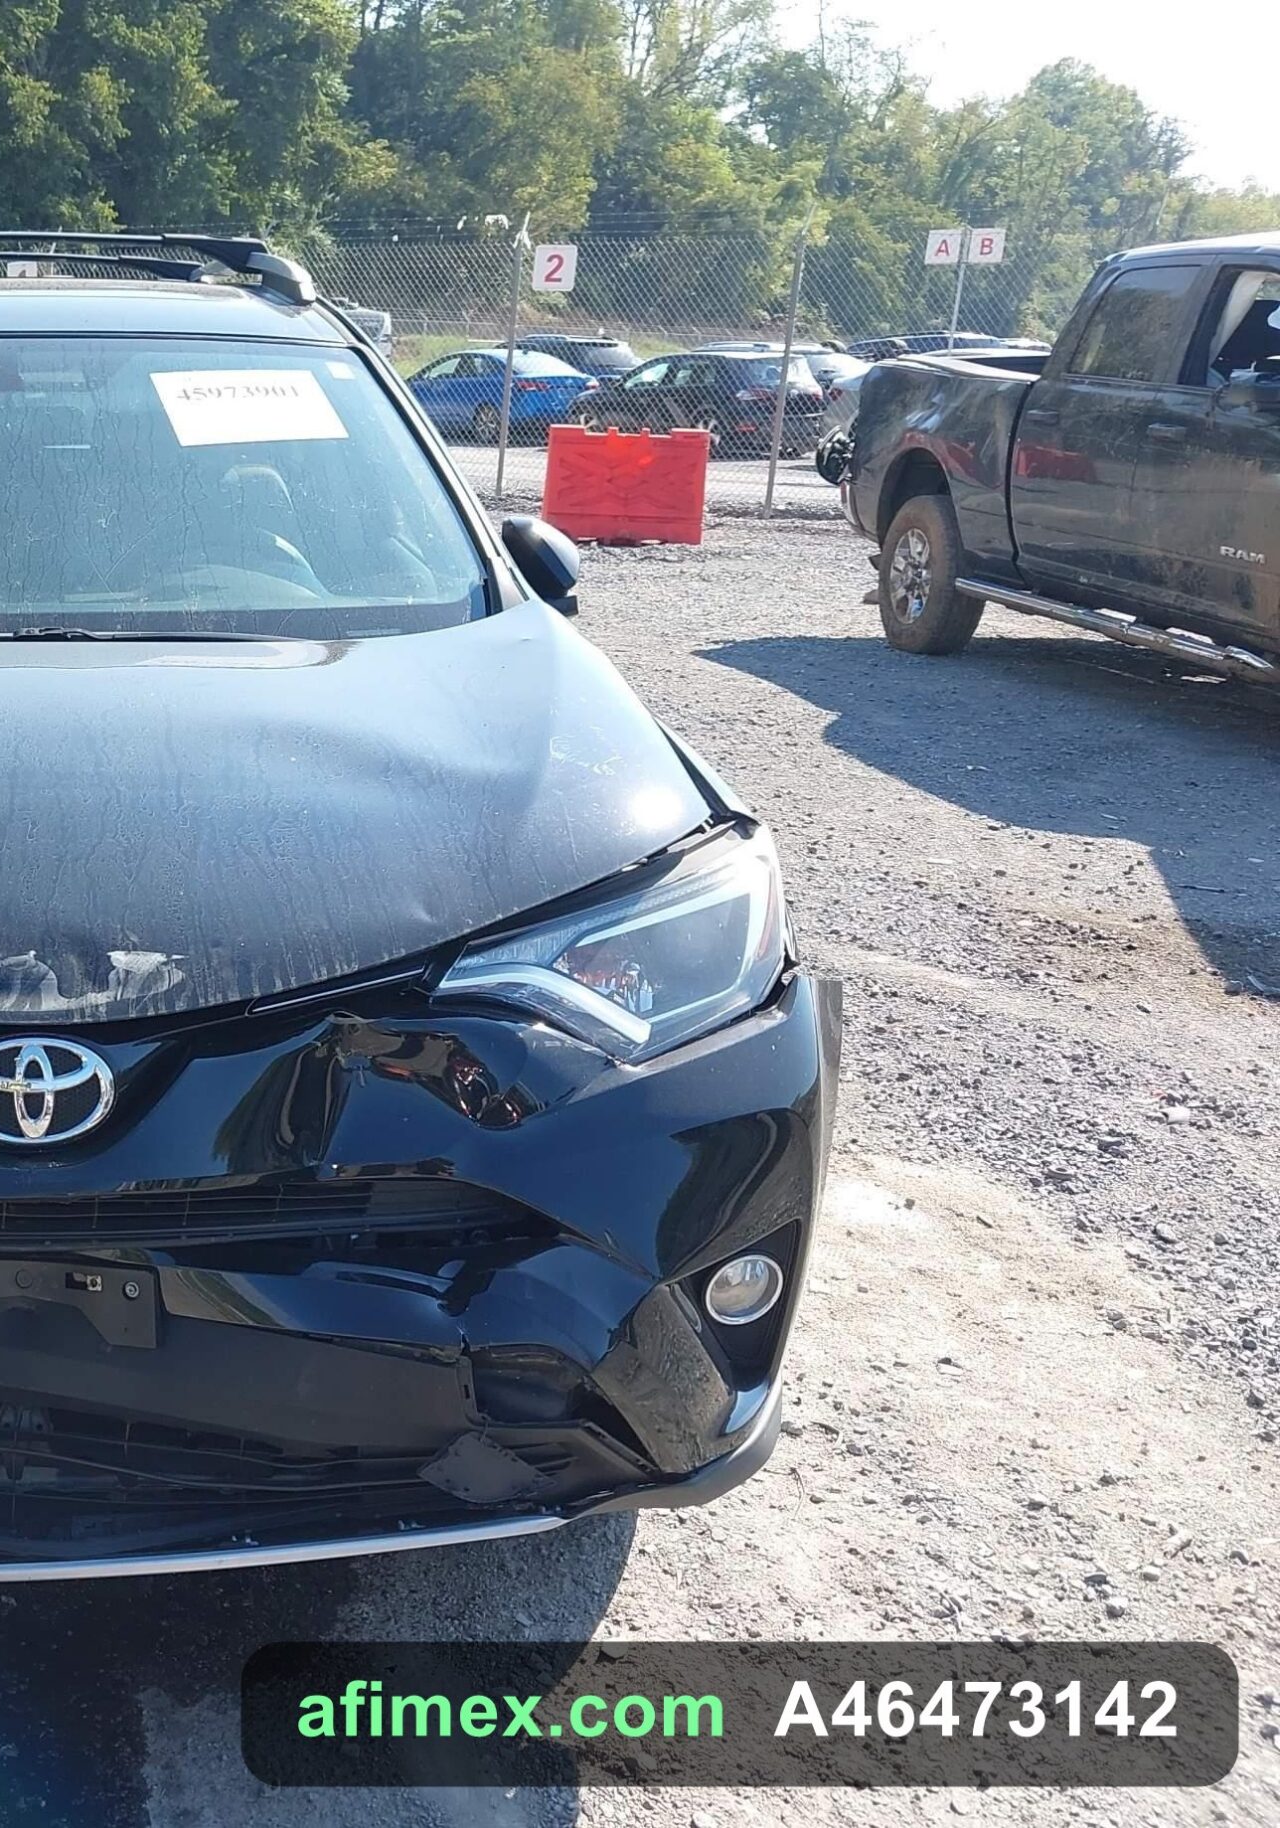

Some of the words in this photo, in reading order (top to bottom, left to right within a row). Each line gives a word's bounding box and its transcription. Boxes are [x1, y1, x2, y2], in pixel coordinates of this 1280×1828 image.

[934, 239, 950, 257] A
[980, 238, 994, 255] B
[544, 254, 564, 282] 2
[1220, 546, 1265, 564] RAM
